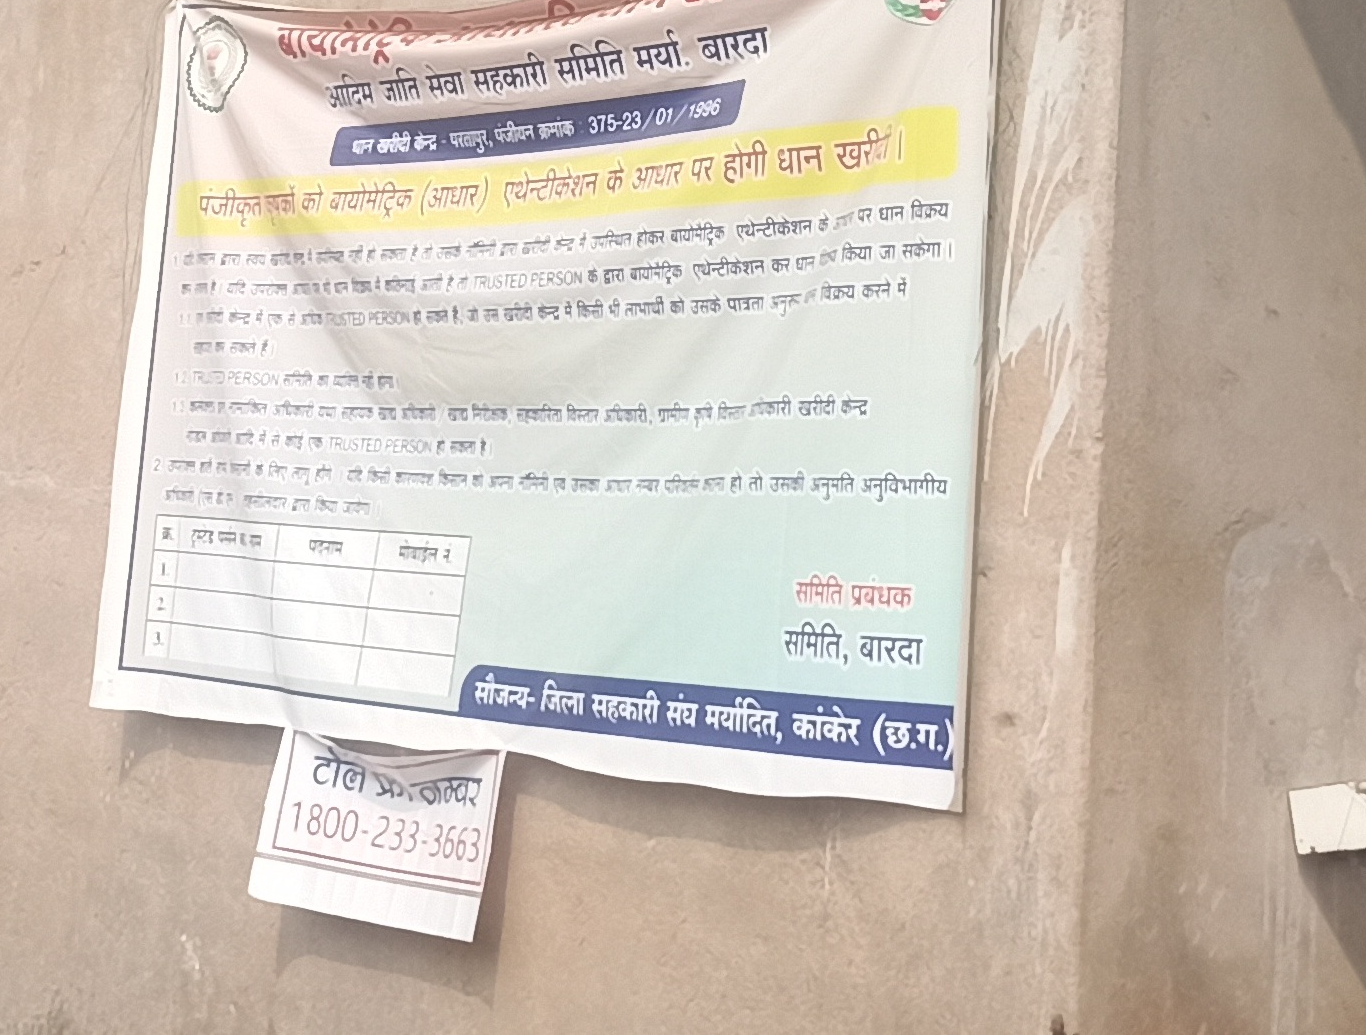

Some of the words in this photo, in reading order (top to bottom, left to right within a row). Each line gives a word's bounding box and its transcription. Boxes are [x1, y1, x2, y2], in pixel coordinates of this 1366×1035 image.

[326, 73, 373, 109] आदिम
[381, 67, 420, 99] जाति
[428, 64, 464, 97] सेवा
[471, 52, 546, 96] सहकारी
[555, 40, 624, 85] समिति
[633, 30, 690, 71] मर्या.
[698, 27, 768, 63] बारदा
[200, 187, 261, 227] पंजीकृत
[302, 183, 324, 214] को
[330, 181, 414, 218] बायोमेट्रिक
[503, 166, 598, 208] एथेन्टीकेशन
[606, 160, 623, 193] के
[631, 162, 683, 191] आधार
[691, 158, 715, 184] पर
[723, 140, 768, 184] होगी
[777, 144, 823, 176] धान
[858, 207, 872, 225] पर
[879, 205, 904, 222] धान
[911, 198, 949, 220] विक्रय
[473, 273, 527, 293] TRUSTED
[530, 269, 583, 288] PERSON
[772, 257, 790, 273] कर
[842, 241, 872, 263] किया
[879, 244, 895, 260] जा
[902, 237, 941, 259] सकेगा
[227, 372, 278, 386] PERSON
[798, 393, 835, 417] खरीदी
[330, 435, 382, 453] TRUSTED
[385, 437, 432, 455] PERSON
[748, 470, 763, 493] तो
[810, 471, 855, 501] अनुमति
[861, 471, 948, 503] अनुविभागीय
[796, 571, 843, 607] समिति
[851, 576, 913, 609] प्रबंधक
[784, 621, 849, 666] समिति,
[859, 635, 923, 667] बारदा
[540, 679, 584, 716] जिला
[592, 688, 659, 727] सहकारी
[666, 692, 697, 728] संघ
[705, 697, 784, 744] मर्यादित,
[792, 710, 861, 746] कांकेर
[872, 712, 955, 762] (छ.ग.)
[313, 746, 366, 794] टोल
[293, 801, 482, 863] 1800-233-3663
